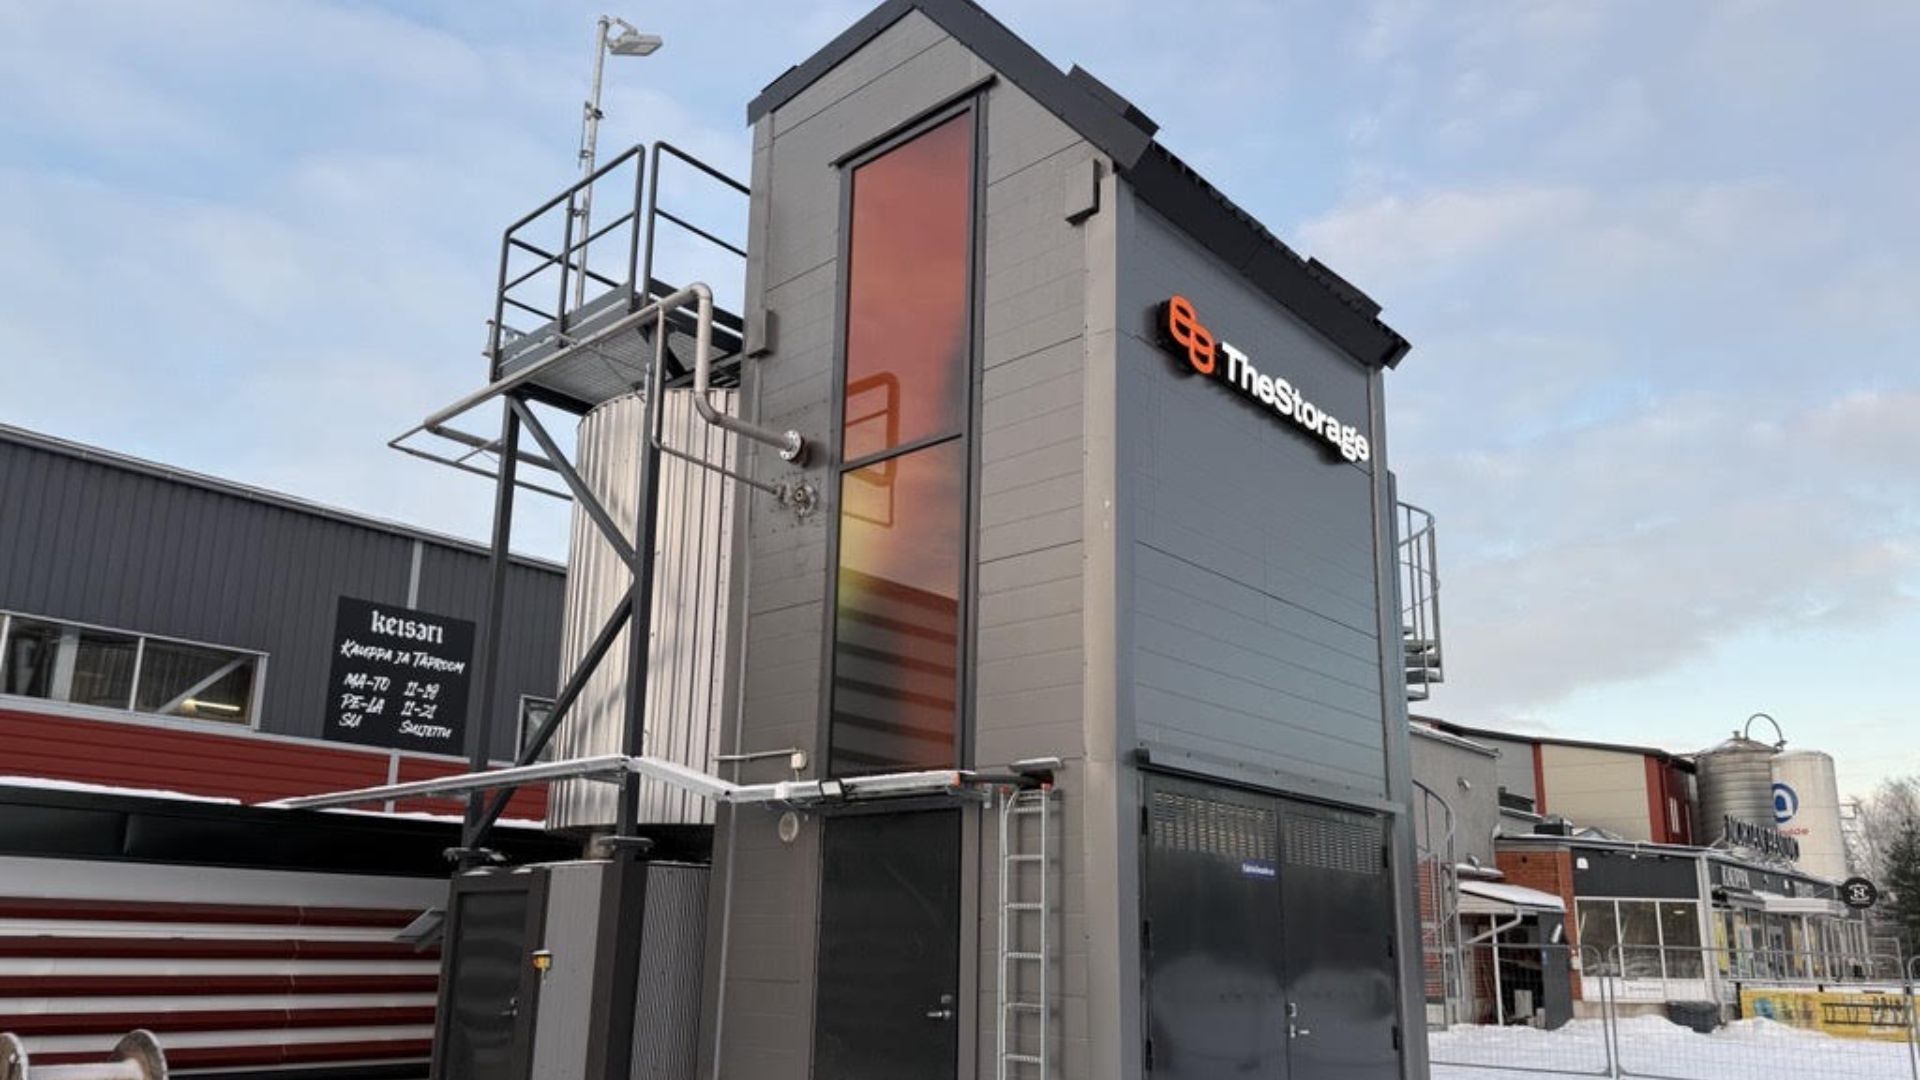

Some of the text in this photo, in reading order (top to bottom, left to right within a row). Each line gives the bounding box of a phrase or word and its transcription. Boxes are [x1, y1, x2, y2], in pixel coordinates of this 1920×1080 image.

[1222, 341, 1370, 462] TheStorage
[394, 651, 410, 665] JA
[413, 651, 466, 674] TAPROOM
[344, 673, 440, 700] MA-TO 11-19
[341, 693, 437, 719] PE-LA 11-21
[339, 712, 362, 728] SU
